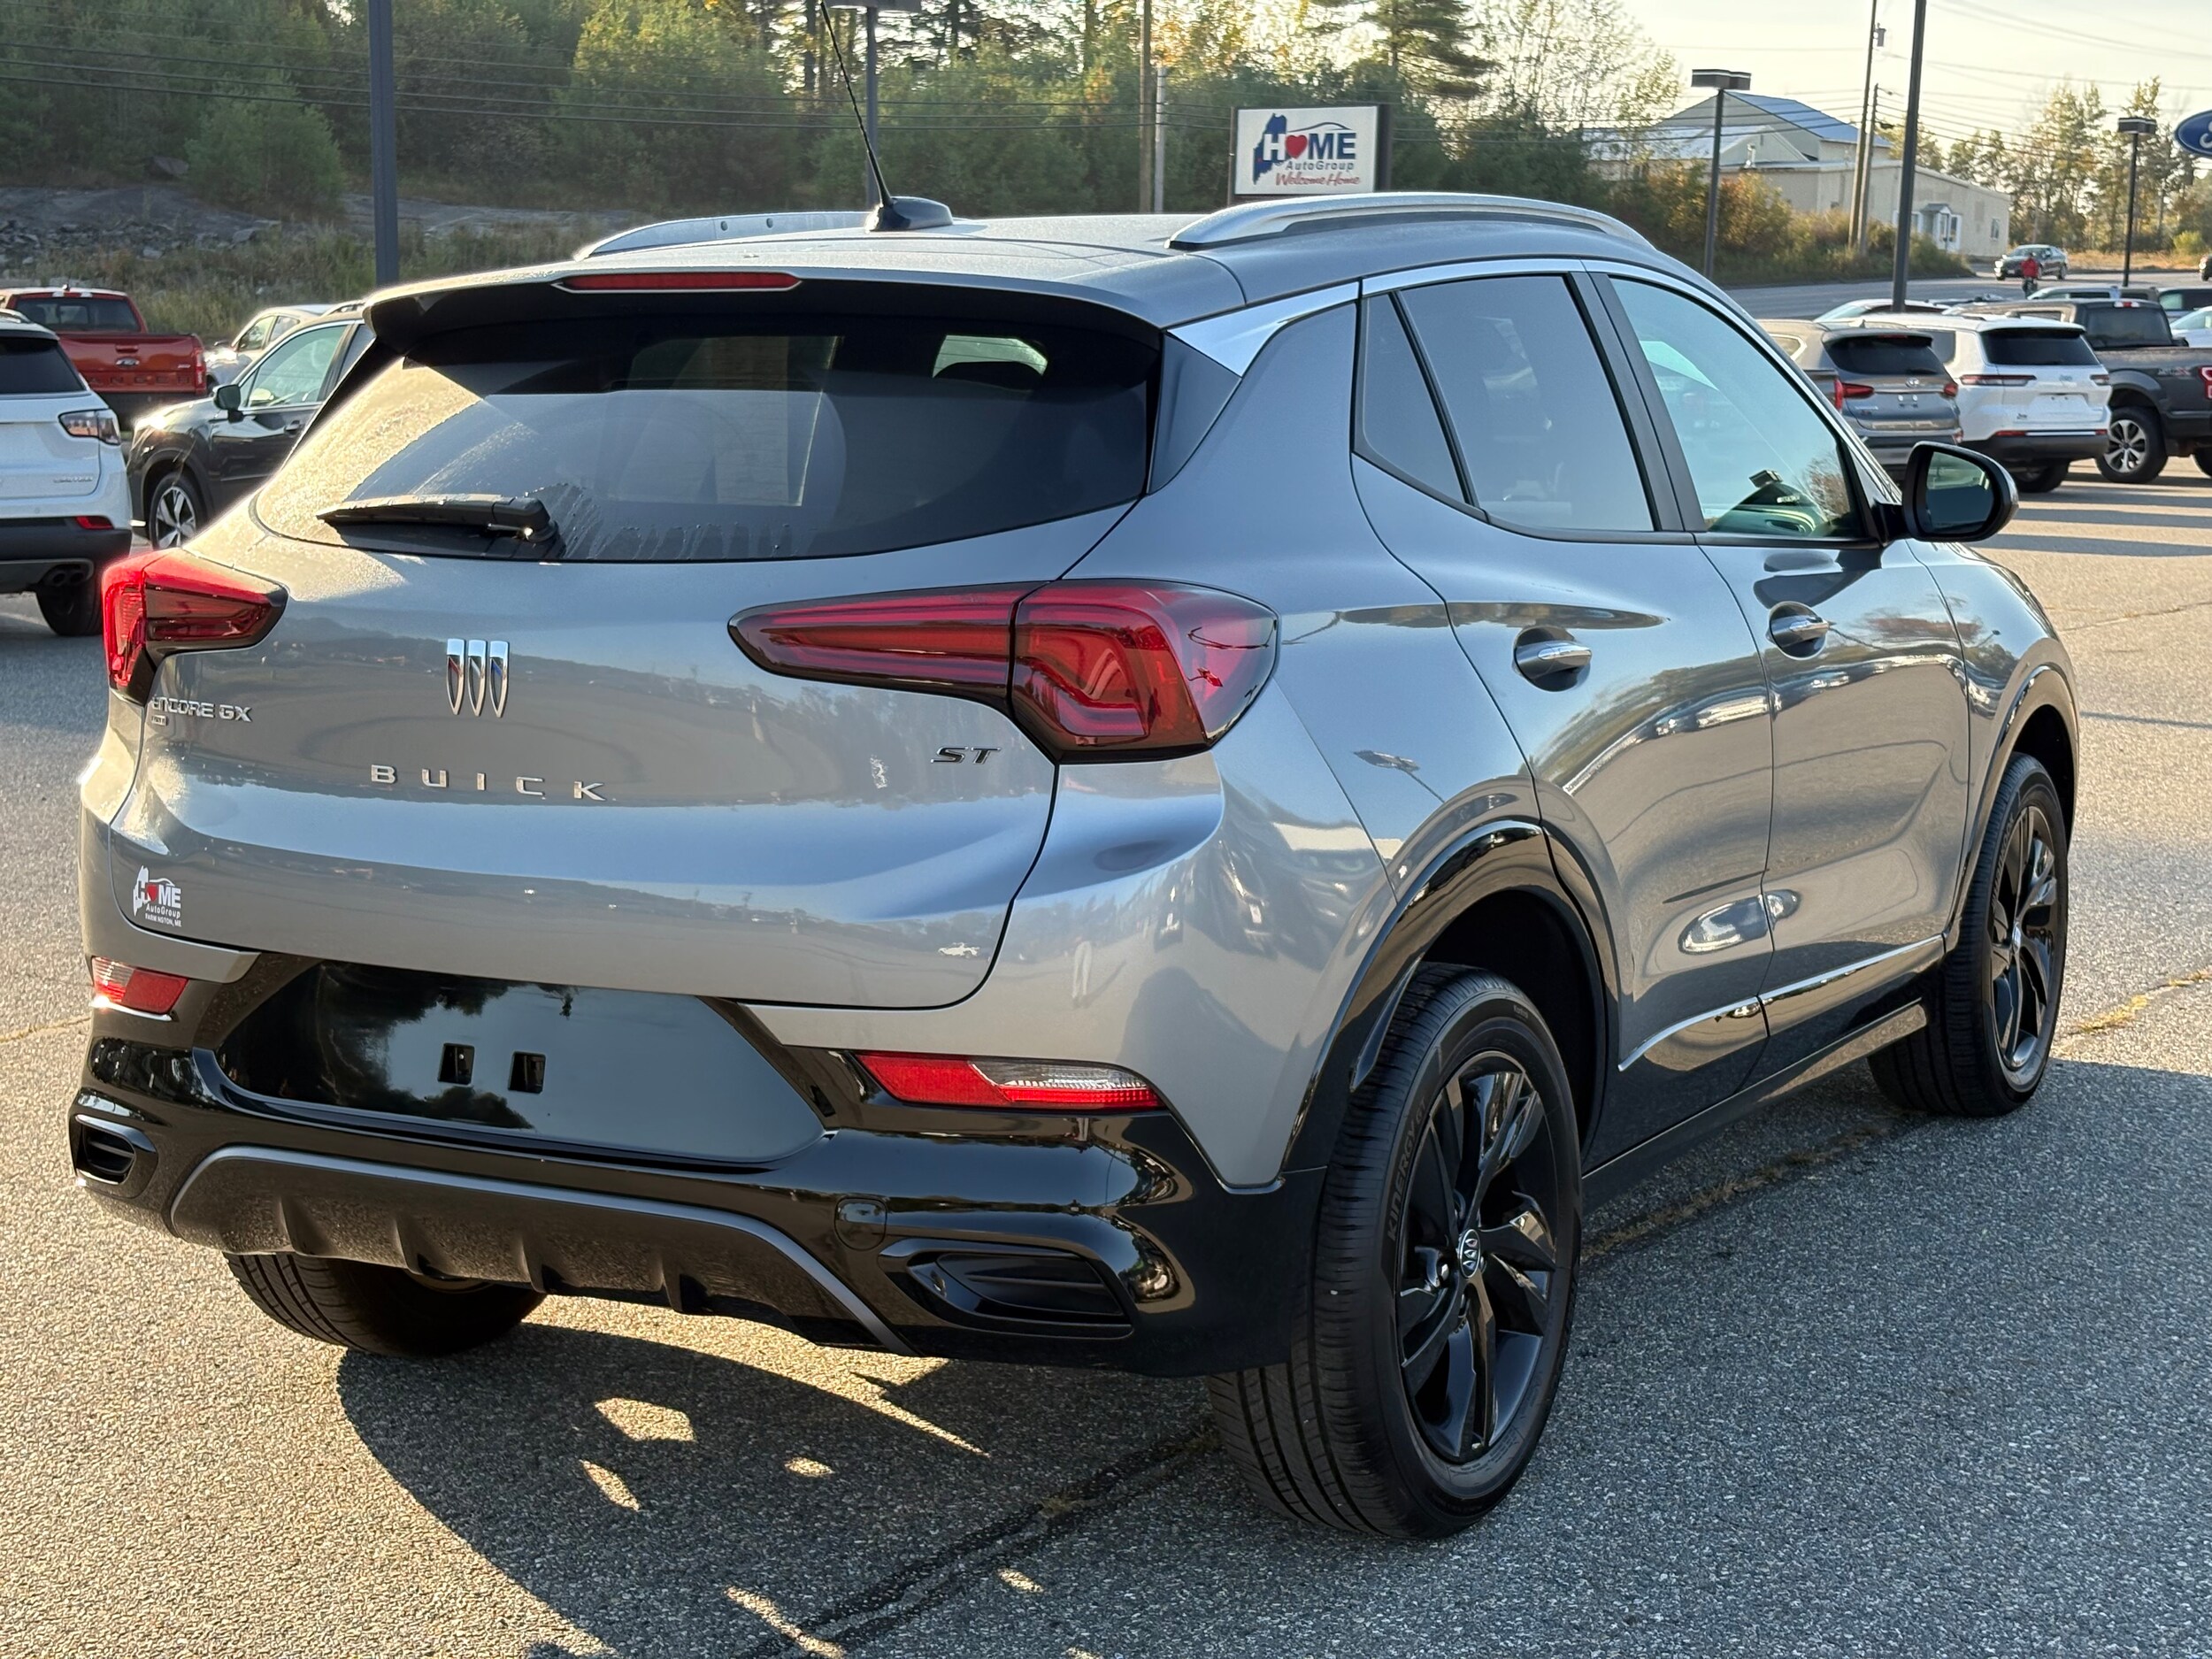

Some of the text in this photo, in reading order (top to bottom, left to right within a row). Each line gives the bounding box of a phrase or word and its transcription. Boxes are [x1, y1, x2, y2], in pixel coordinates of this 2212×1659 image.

[1286, 160, 1355, 173] AutoGroup
[1276, 172, 1360, 186] Welcome Home
[152, 696, 252, 722] ENCORE GX
[930, 746, 1001, 764] ST
[371, 764, 606, 801] BUICK
[145, 903, 181, 919] AutoGroup
[1386, 1119, 1417, 1241] KINERGY
